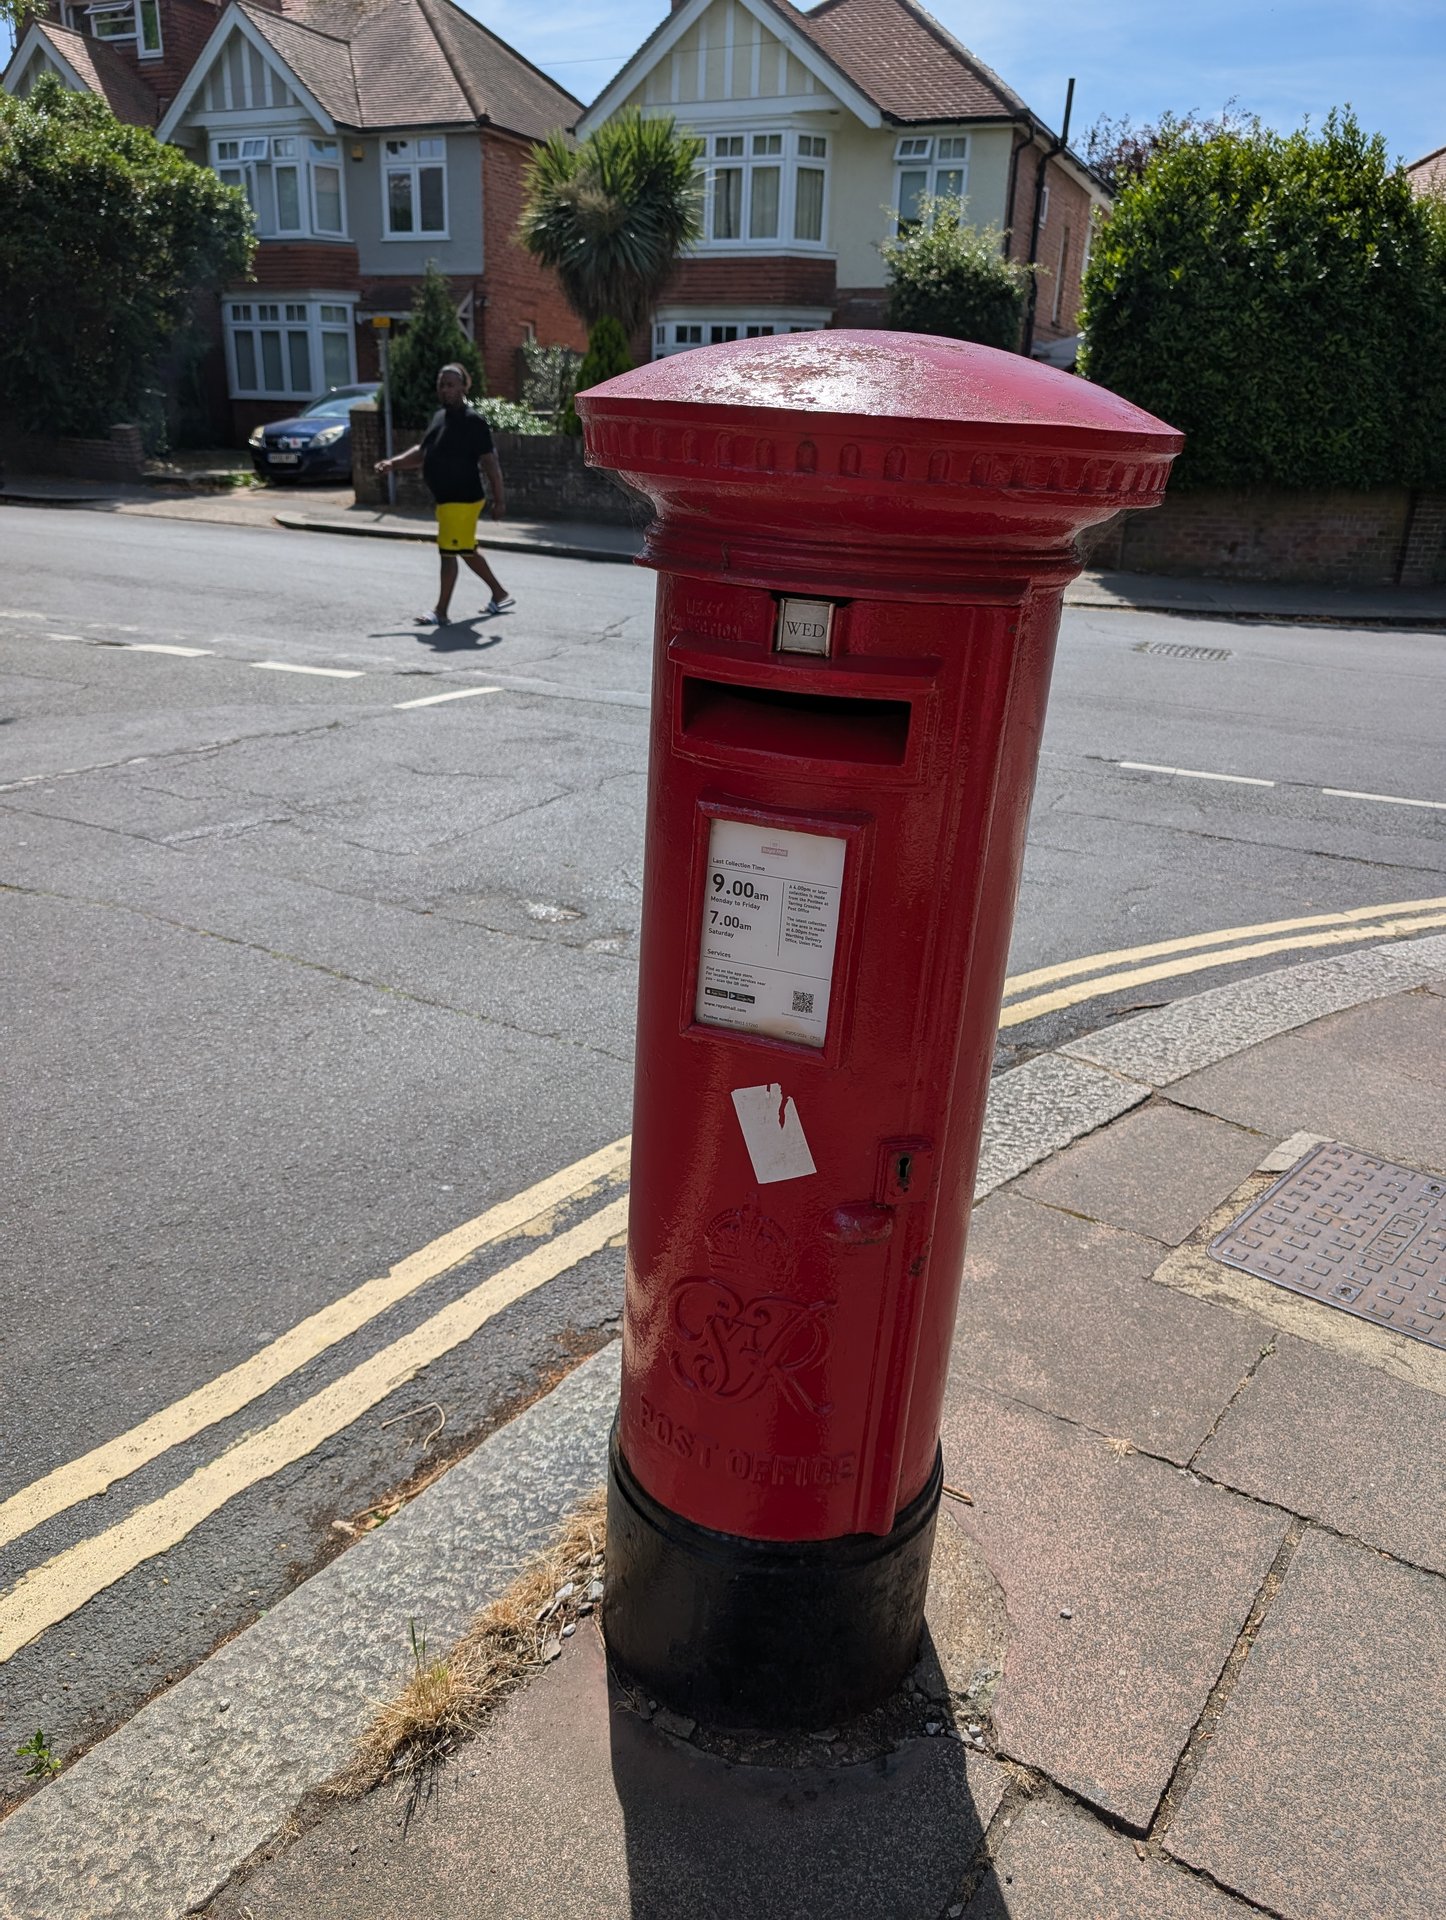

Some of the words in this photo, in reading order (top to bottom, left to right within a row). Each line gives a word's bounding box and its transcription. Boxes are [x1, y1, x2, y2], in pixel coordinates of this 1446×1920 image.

[786, 620, 825, 638] WED
[726, 860, 751, 869] Collection
[712, 874, 769, 901] 9.00am
[711, 896, 733, 906] Monday
[743, 901, 760, 910] Friday
[710, 910, 752, 931] 7.00am
[709, 928, 734, 938] Saturday
[708, 949, 731, 958] Services
[640, 1391, 718, 1468] POST
[726, 1448, 856, 1486] OFFICE
